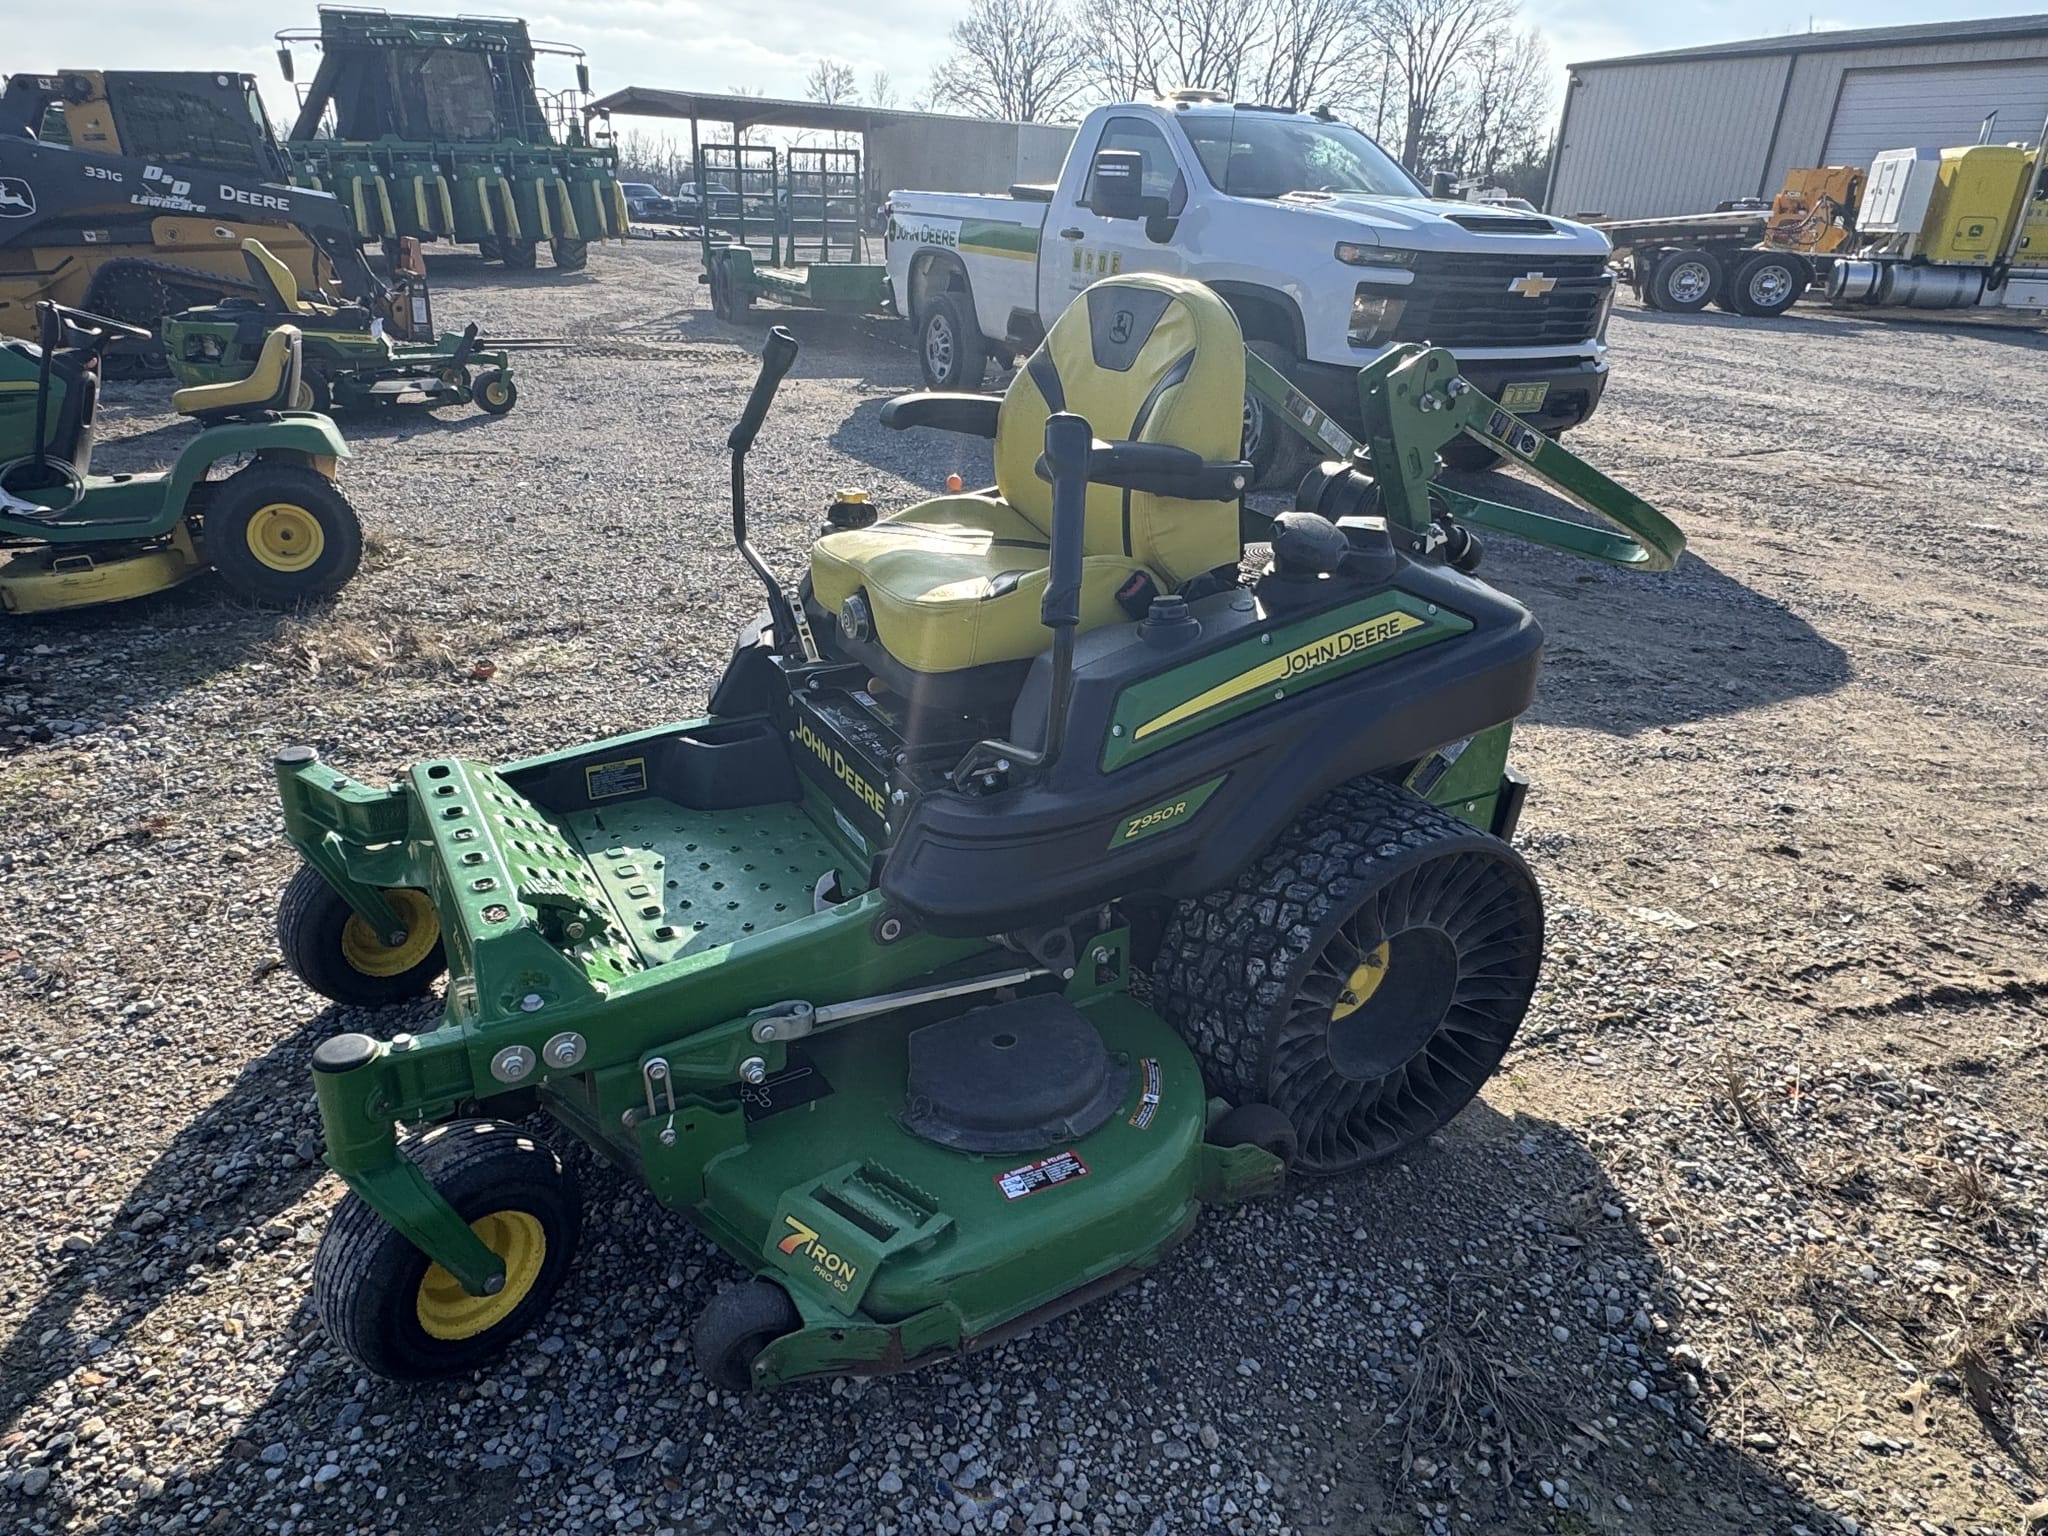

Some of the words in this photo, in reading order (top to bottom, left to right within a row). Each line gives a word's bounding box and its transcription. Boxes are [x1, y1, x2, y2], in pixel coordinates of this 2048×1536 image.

[84, 166, 123, 182] 331G
[130, 194, 207, 213] Lawncare
[219, 184, 290, 212] DEERE
[896, 224, 919, 241] JOHN
[921, 223, 957, 247] DEERE
[1280, 642, 1334, 677] JOHN
[1338, 618, 1400, 653] DEERE
[795, 716, 831, 768] JOHN
[834, 749, 885, 820] DEERE
[1125, 802, 1187, 838] Z950R
[804, 1239, 857, 1283] IRON
[812, 1264, 833, 1282] PRO
[833, 1279, 849, 1292] 60
